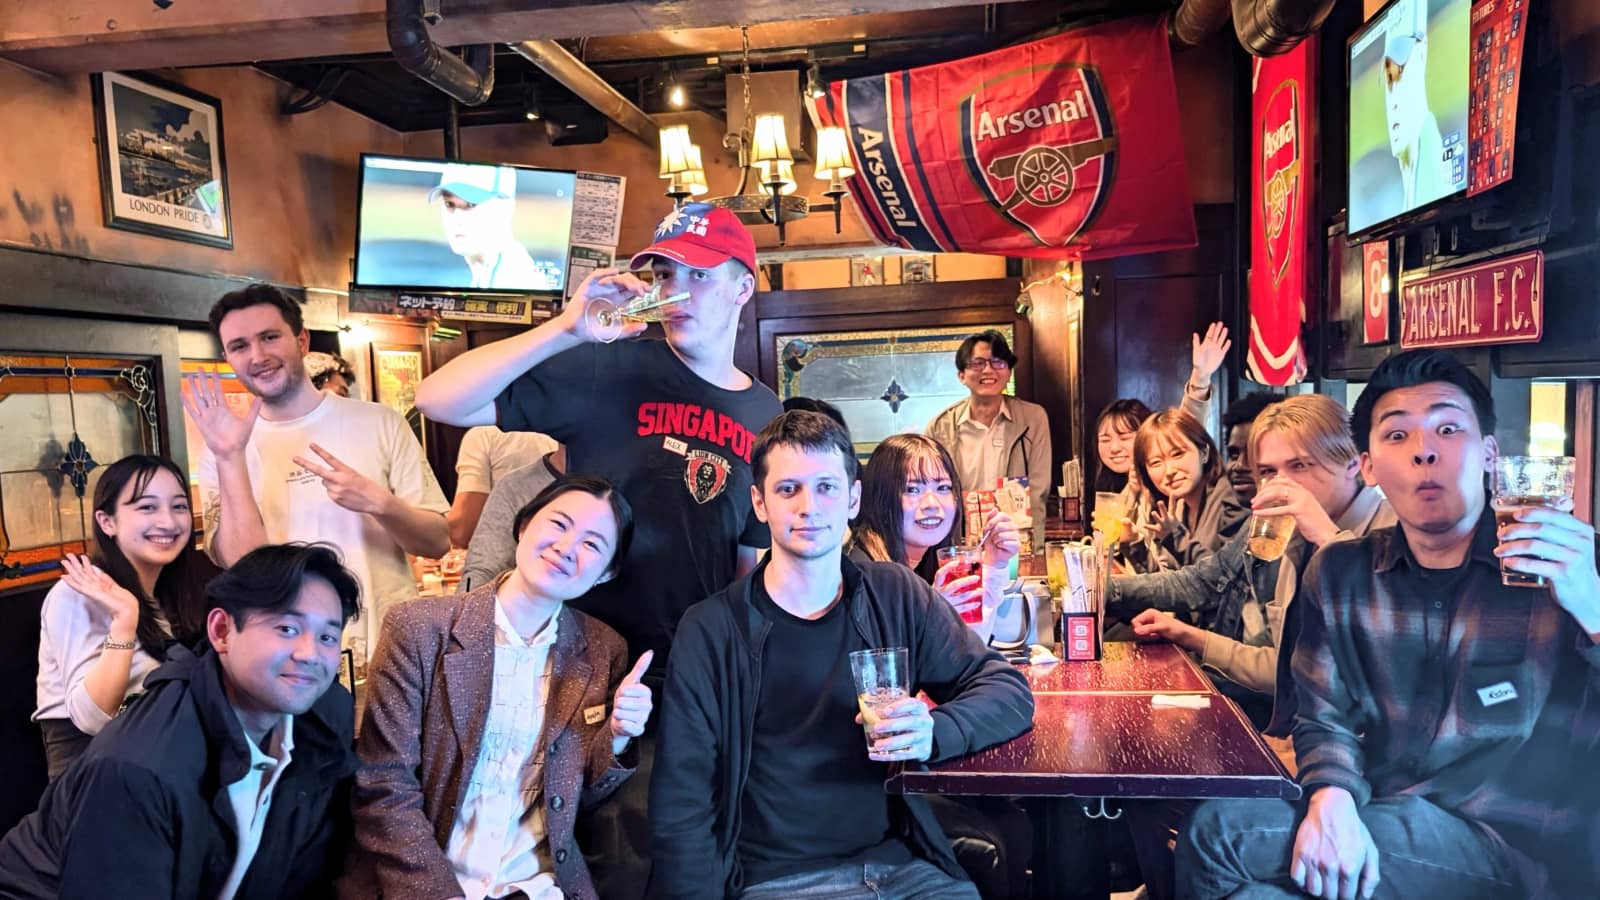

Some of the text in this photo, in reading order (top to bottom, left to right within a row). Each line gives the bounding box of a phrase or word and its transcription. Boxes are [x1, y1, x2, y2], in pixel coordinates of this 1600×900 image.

[977, 89, 1089, 141] Arsenal
[858, 127, 918, 227] Arsenal
[129, 199, 199, 224] LONDON PRIDE
[1370, 259, 1383, 319] 8
[1409, 265, 1530, 341] ARSENAL F.C.
